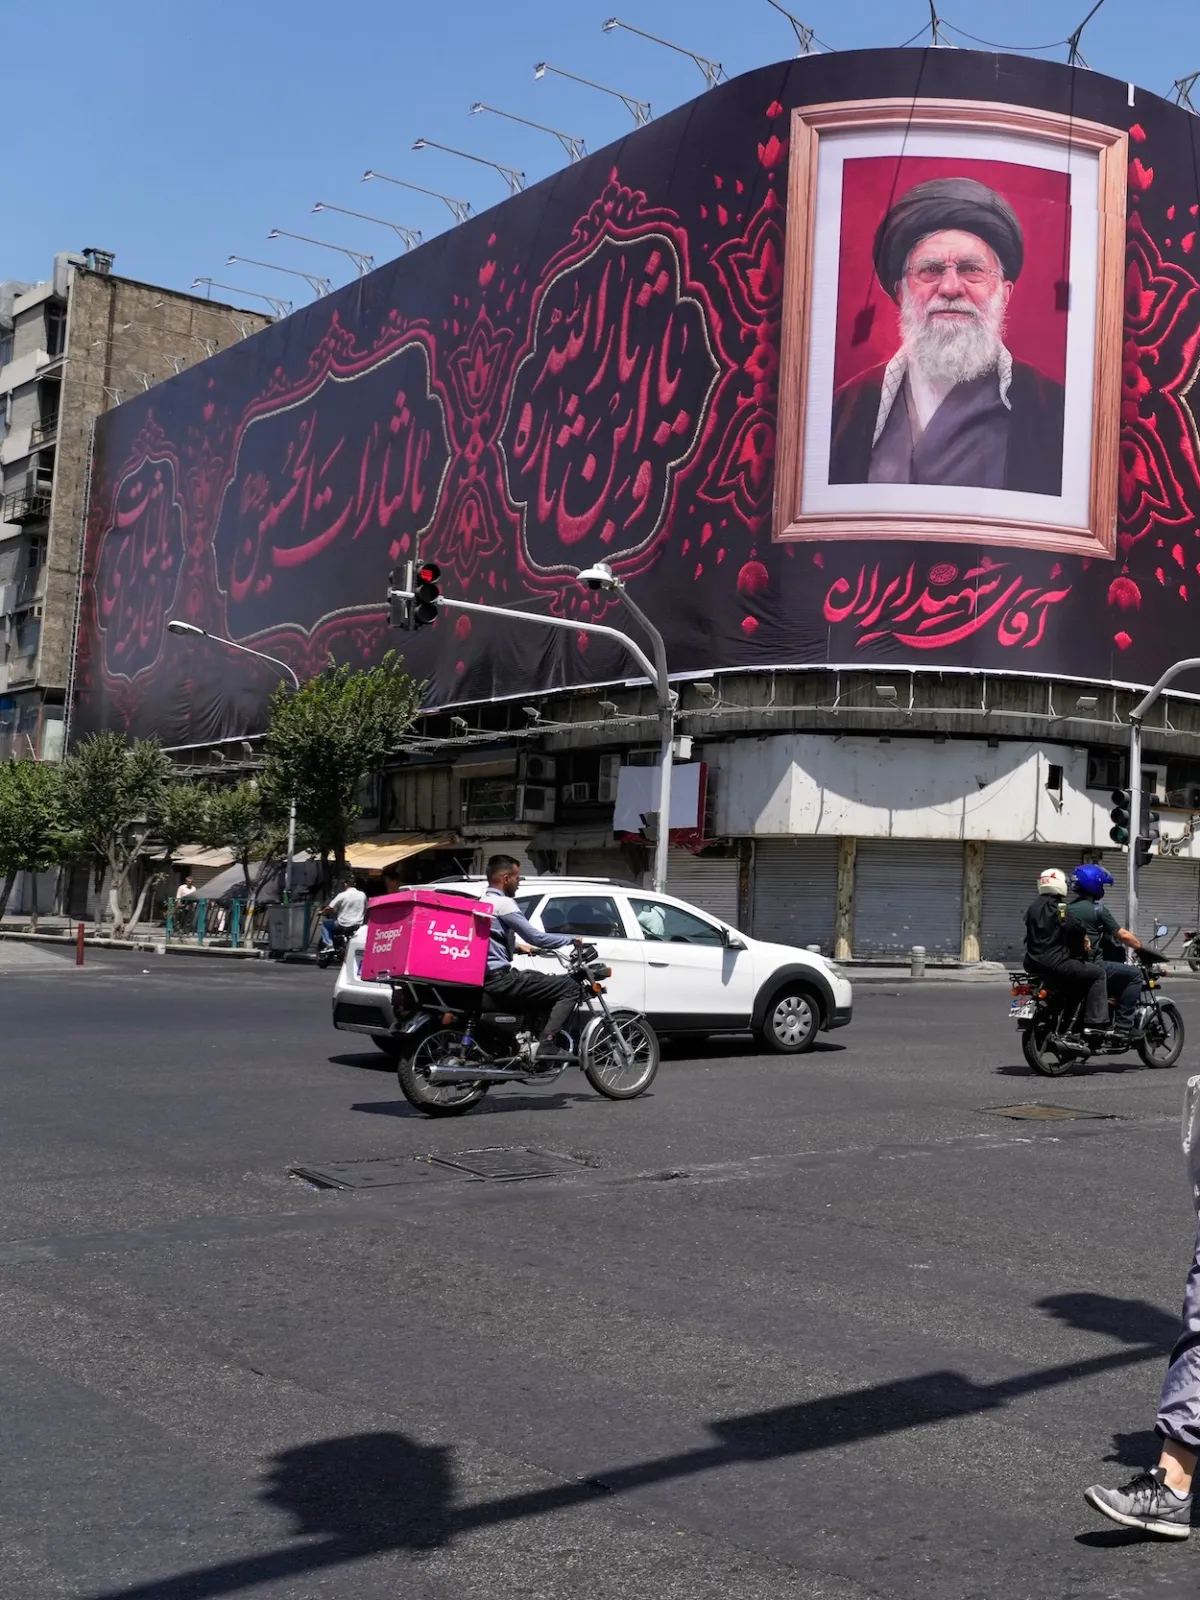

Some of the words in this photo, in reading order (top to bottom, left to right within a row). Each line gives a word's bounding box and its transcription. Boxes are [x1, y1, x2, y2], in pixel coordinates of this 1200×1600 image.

[823, 560, 916, 647] ایران
[892, 556, 1013, 634] شهید
[892, 575, 1073, 649] آقای
[372, 939, 392, 954] Food
[374, 925, 402, 943] Snapp!
[440, 944, 470, 960] فود
